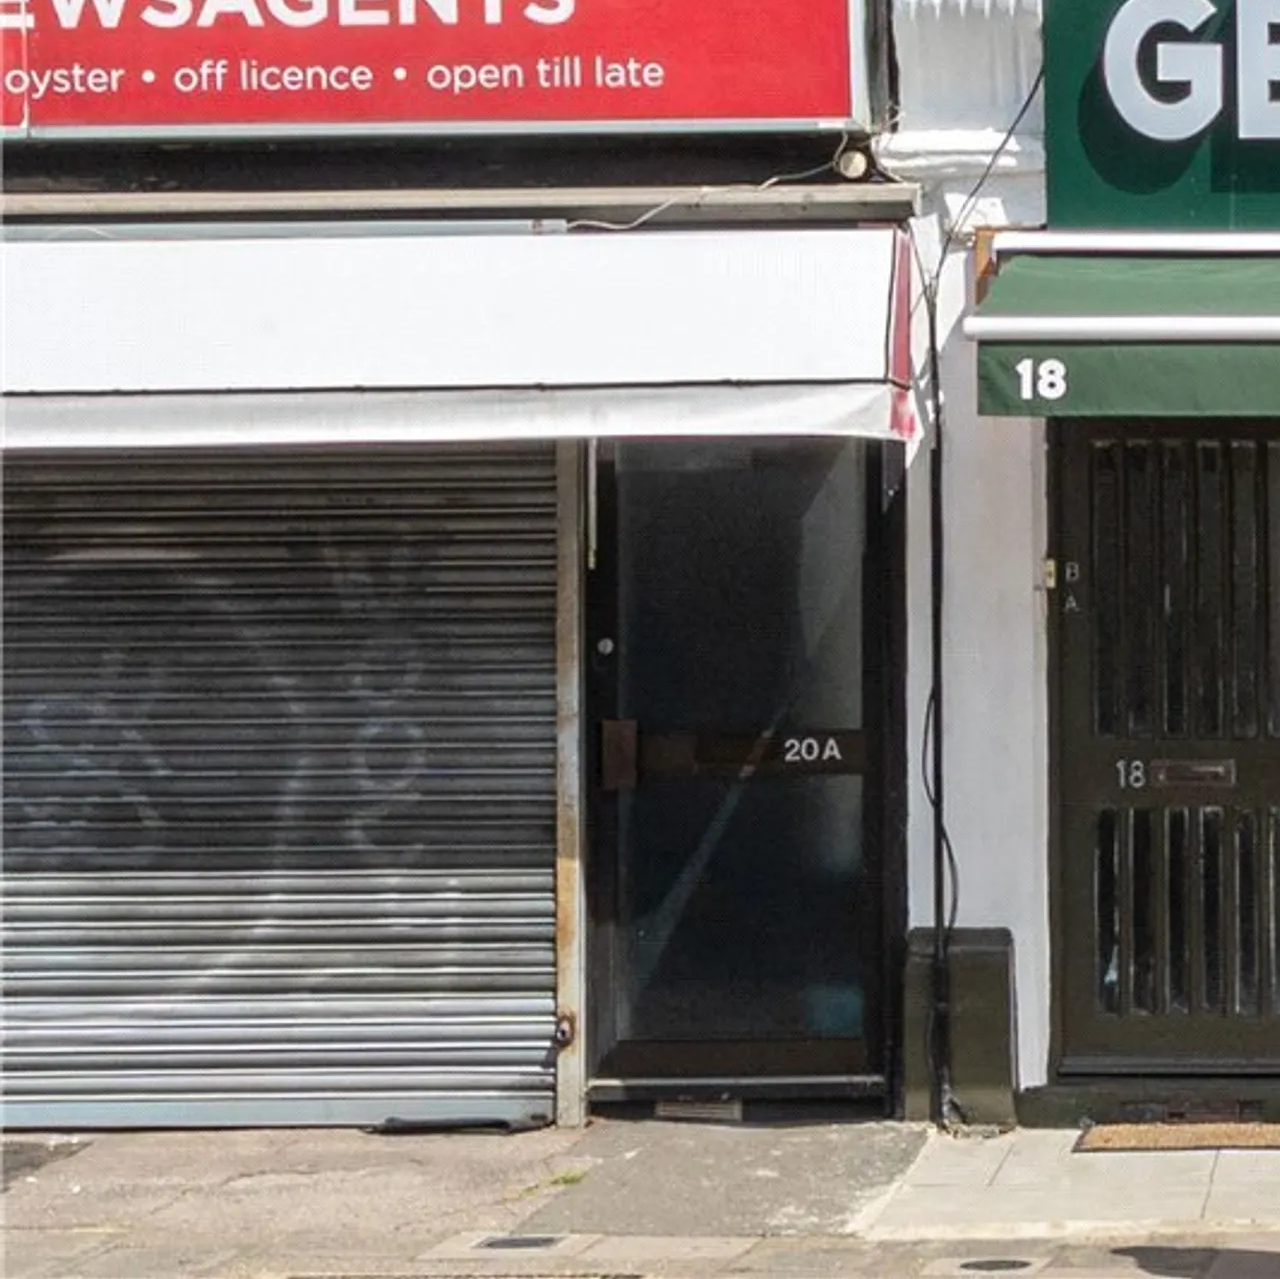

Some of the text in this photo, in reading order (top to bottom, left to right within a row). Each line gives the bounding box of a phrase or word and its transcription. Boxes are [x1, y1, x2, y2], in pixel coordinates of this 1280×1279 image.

[4, 55, 664, 99] oyster off licence open till late
[1015, 359, 1067, 400] 18
[784, 737, 842, 761] 20A
[1115, 759, 1146, 789] 18
